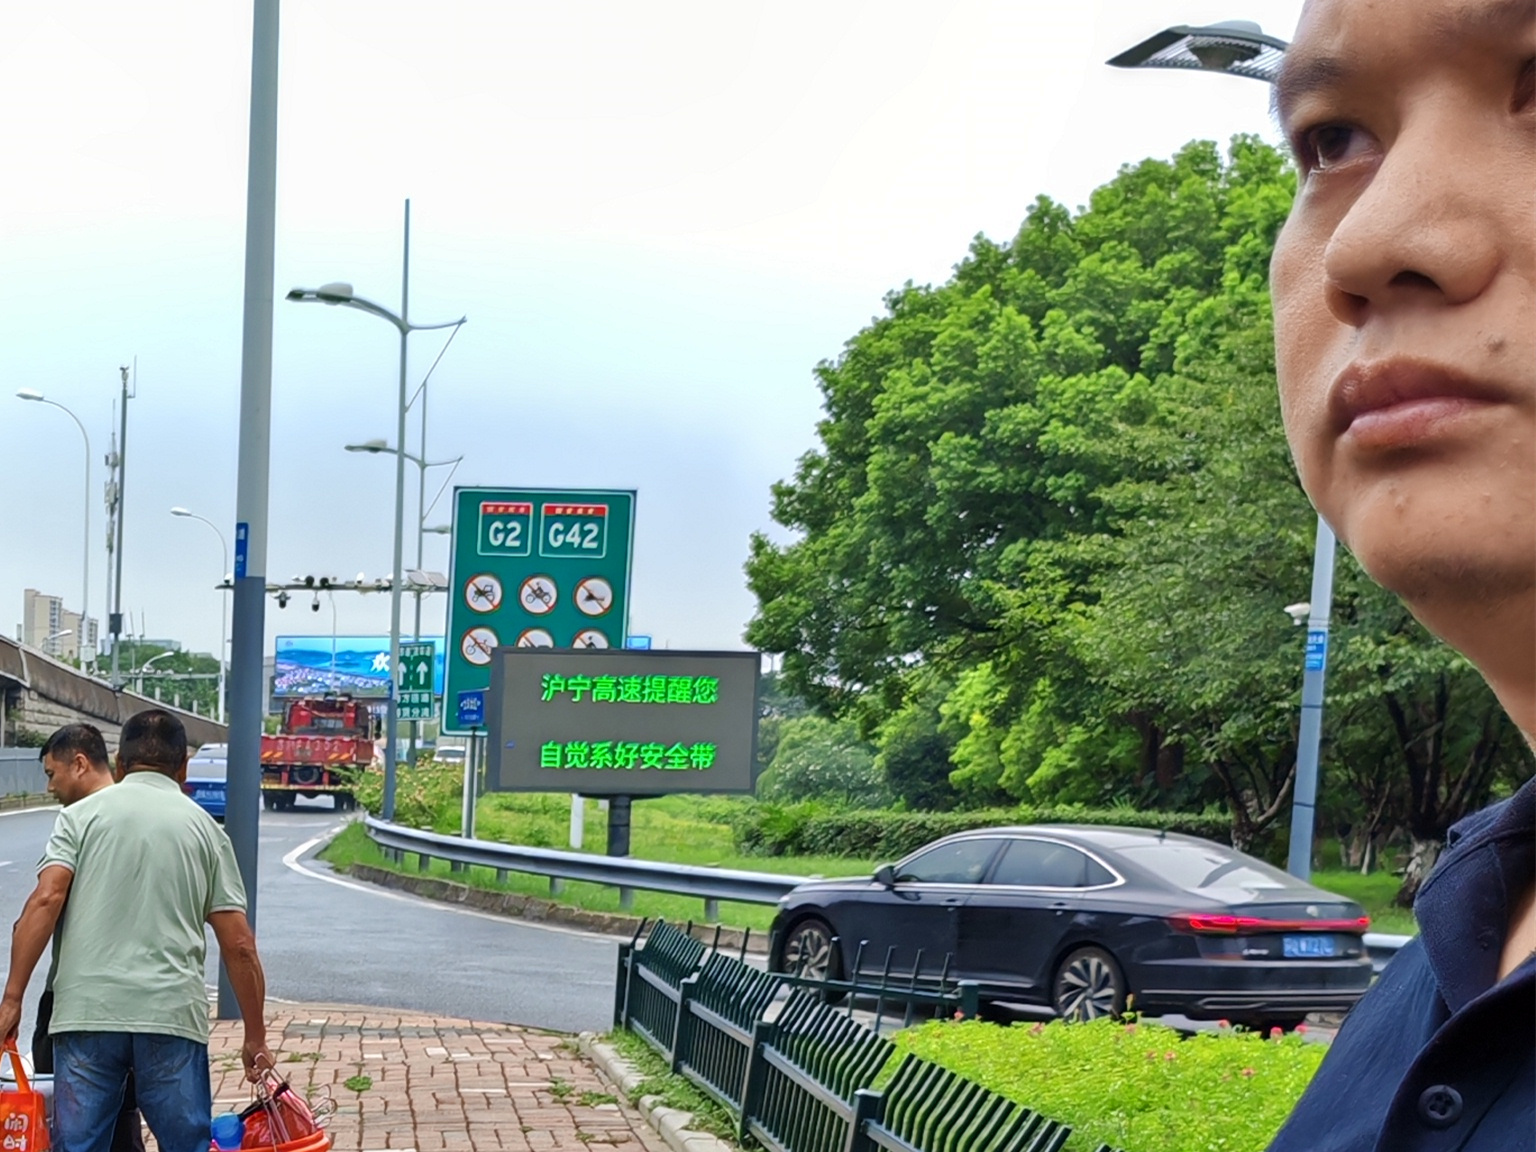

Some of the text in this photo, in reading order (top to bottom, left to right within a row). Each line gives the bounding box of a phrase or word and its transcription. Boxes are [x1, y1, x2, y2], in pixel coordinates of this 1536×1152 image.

[488, 521, 522, 547] G2
[548, 522, 599, 549] G42
[540, 673, 719, 704] 沪宁高速提醒您
[539, 740, 717, 770] 自觉系好安全带
